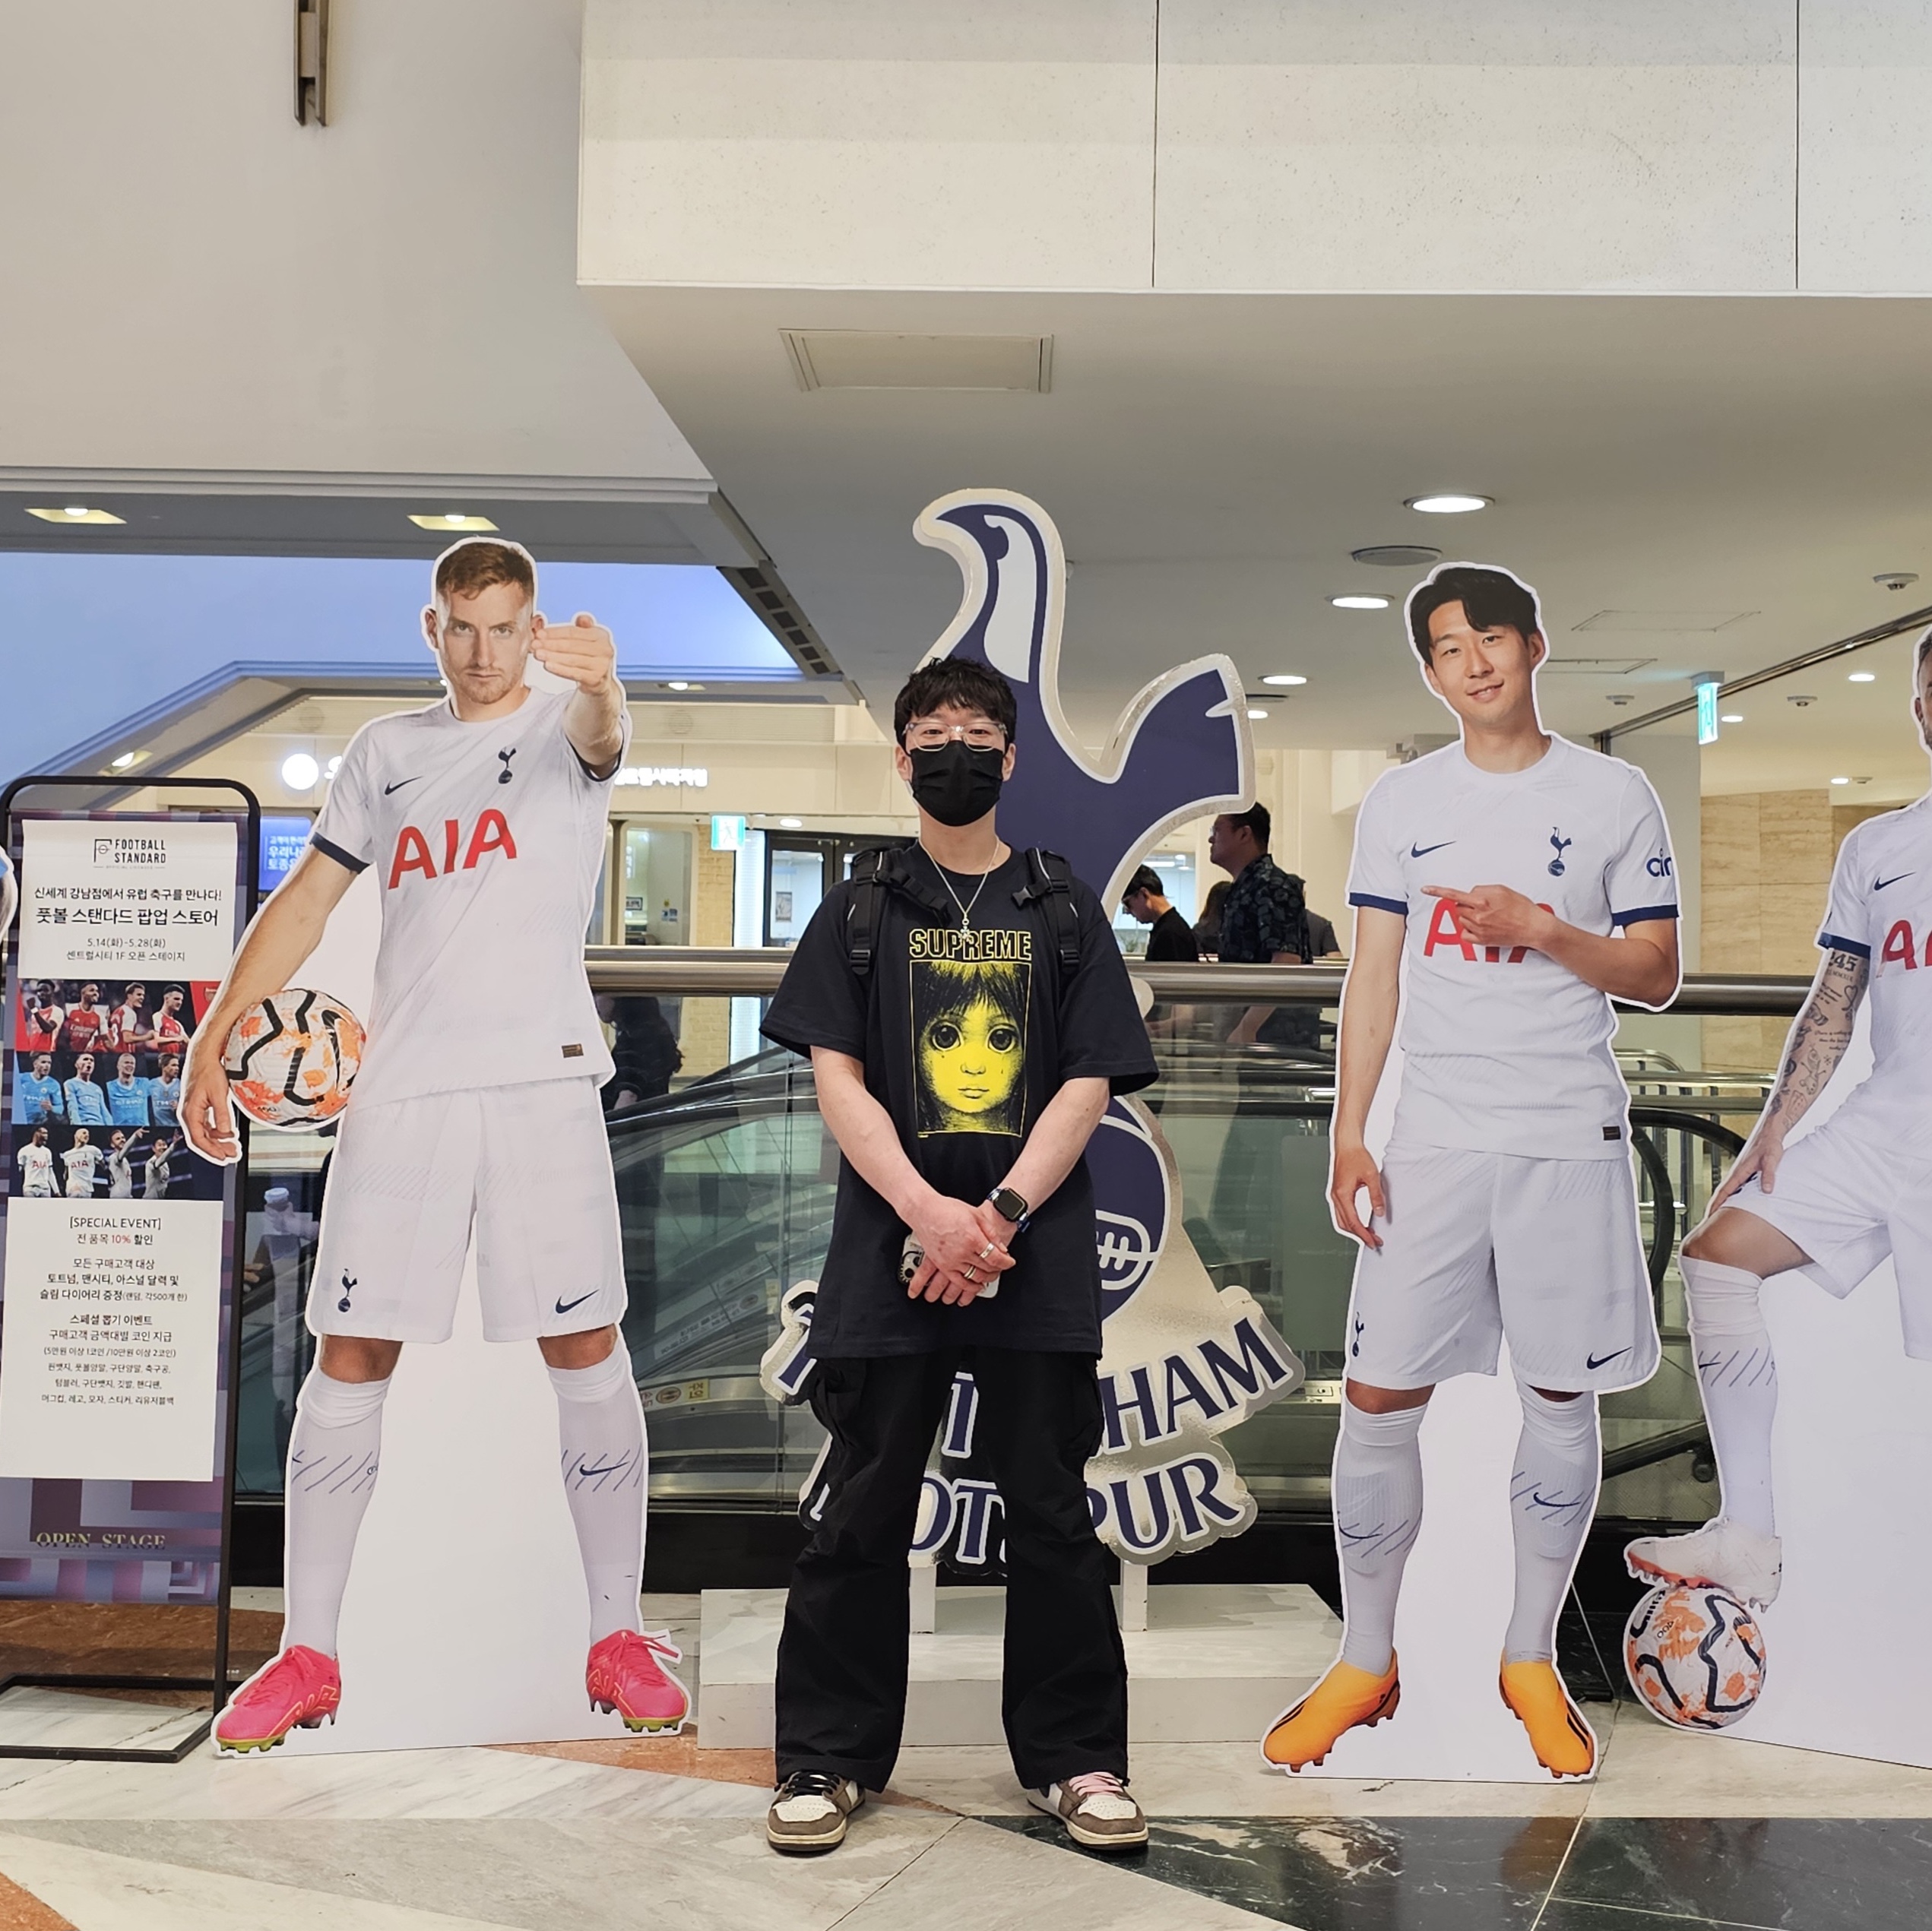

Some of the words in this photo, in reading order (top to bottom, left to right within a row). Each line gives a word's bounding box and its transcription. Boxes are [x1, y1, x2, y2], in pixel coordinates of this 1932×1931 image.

[116, 840, 166, 850] FOOTBALL
[388, 809, 518, 890] AIA
[115, 853, 166, 863] STANDARD
[35, 888, 67, 899] 신세계
[70, 888, 123, 900] 강남점에서
[127, 888, 147, 901] 유럽
[150, 889, 182, 901] 축구를
[185, 889, 221, 901] 만나다!
[36, 908, 68, 924] 풋볼
[71, 908, 133, 924] 스탠다드
[138, 909, 167, 926] 팝업
[172, 909, 218, 926] 스토어
[910, 928, 1032, 961] SUPREME
[67, 951, 112, 961] 센트럴시티
[116, 951, 125, 960] 1F
[128, 951, 146, 961] 오픈
[150, 952, 185, 961] 스테이지
[70, 1217, 118, 1229] [SPECIAL
[121, 1218, 160, 1230] EVENT]
[77, 1233, 86, 1244] 전
[90, 1234, 108, 1244] 품목
[112, 1234, 131, 1243] 10%
[135, 1234, 153, 1246] 할인
[73, 1258, 92, 1269] 모든
[95, 1259, 133, 1269] 구매고객
[136, 1259, 154, 1270] 대상
[116, 1274, 144, 1286] 아스널
[147, 1275, 166, 1286] 달력
[170, 1275, 179, 1286] 및
[40, 1289, 59, 1299] 슬림
[62, 1289, 100, 1300] 다이어리
[70, 1315, 100, 1325] 스페셜
[103, 1315, 121, 1325] 뽑기
[124, 1315, 152, 1325] 이벤트
[49, 1330, 87, 1341] 구매고객
[131, 1331, 150, 1342] 코인
[154, 1331, 172, 1342] 지급
[36, 1532, 91, 1548] OPEN
[101, 1533, 166, 1550] STAGE
